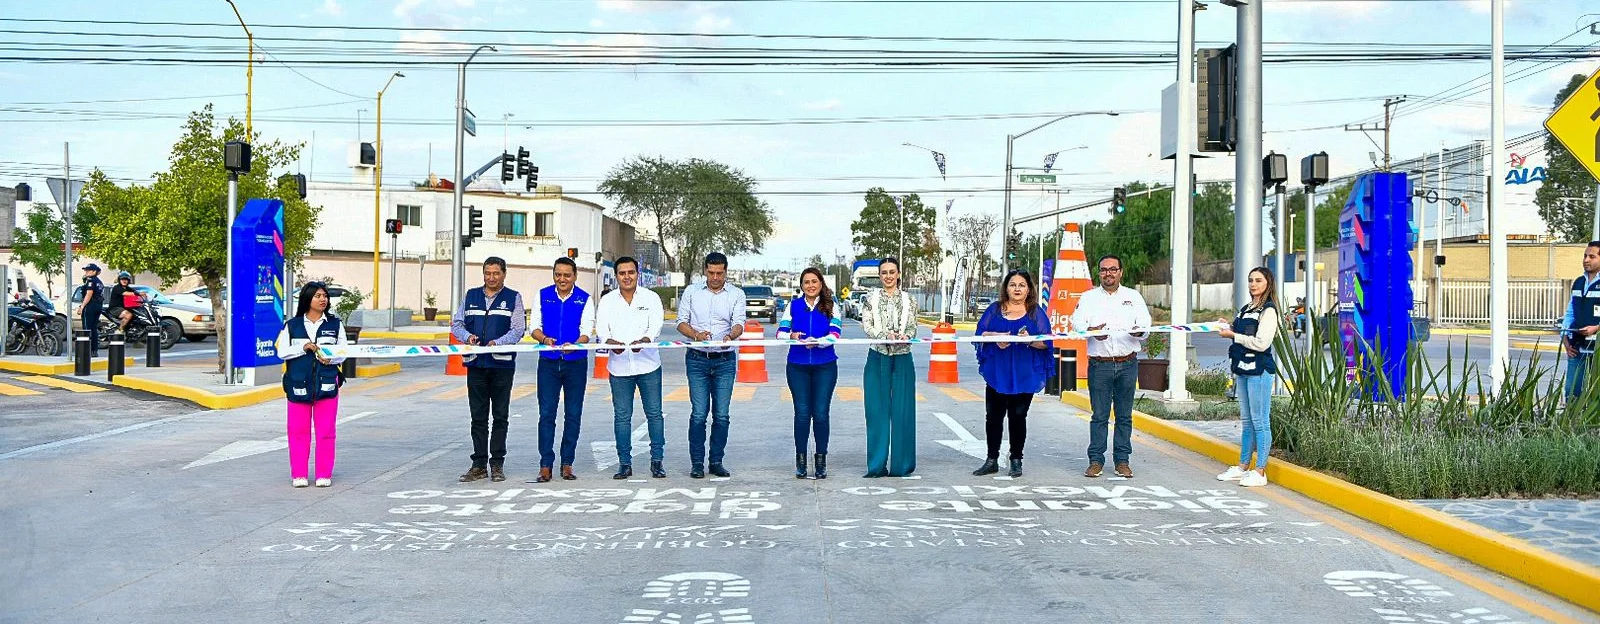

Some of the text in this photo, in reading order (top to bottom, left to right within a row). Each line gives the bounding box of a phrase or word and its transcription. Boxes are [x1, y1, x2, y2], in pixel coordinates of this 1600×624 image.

[386, 487, 718, 501] México
[840, 486, 1178, 498] México
[387, 498, 782, 516] gigante
[878, 496, 1269, 512] gigante
[316, 530, 722, 542] AGUASCALIENTES
[1080, 536, 1352, 546] GOBIERNO
[262, 542, 455, 552] ESTADO
[507, 540, 778, 550] GOBIERNO
[838, 538, 1023, 548] ESTADO
